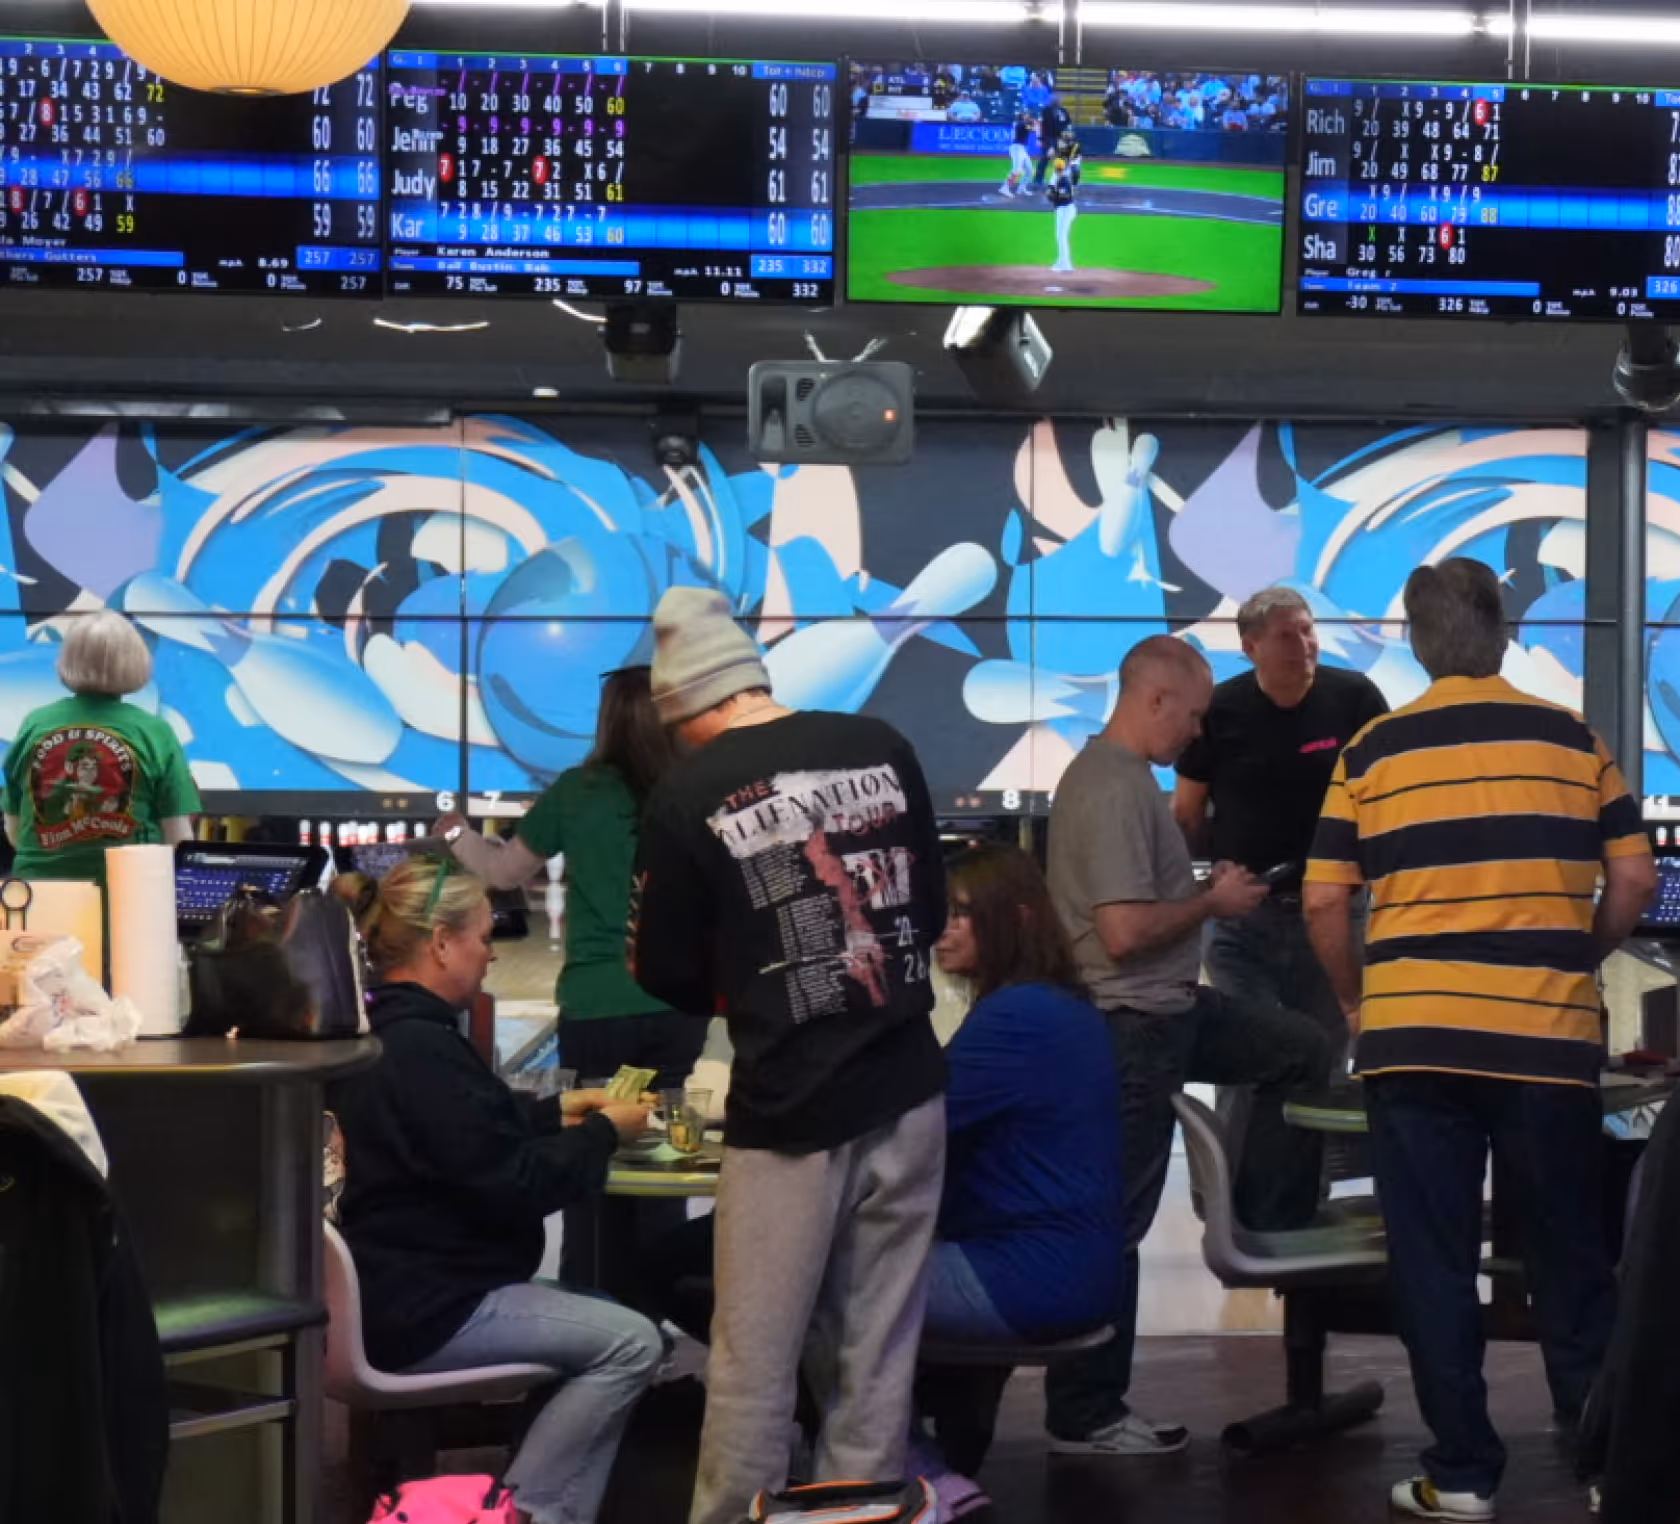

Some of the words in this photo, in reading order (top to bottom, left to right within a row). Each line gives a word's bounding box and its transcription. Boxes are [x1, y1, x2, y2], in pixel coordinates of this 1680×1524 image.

[19, 80, 35, 97] 17
[50, 81, 68, 98] 34
[82, 82, 100, 99] 43
[114, 83, 132, 101] 62
[147, 85, 163, 102] 72
[357, 74, 373, 107] 72
[770, 83, 787, 115] 60
[813, 85, 830, 117] 60
[450, 93, 466, 110] 10
[481, 94, 498, 111] 20
[512, 95, 530, 111] 30
[544, 96, 562, 112] 40
[575, 97, 593, 113] 50
[607, 97, 624, 114] 60
[1306, 108, 1344, 133] Rich
[1363, 120, 1379, 136] 20
[1392, 121, 1409, 137] 39
[1423, 122, 1440, 138] 48
[1454, 123, 1469, 139] 64
[1484, 123, 1499, 139] 71
[20, 124, 36, 141] 27
[51, 125, 68, 142] 36
[83, 126, 100, 143] 44
[116, 127, 132, 144] 51
[147, 128, 164, 146] 60
[313, 115, 330, 149] 60
[357, 117, 374, 151] 60
[769, 127, 786, 160] 54
[812, 128, 829, 160] 54
[458, 137, 466, 153] 9
[482, 138, 498, 154] 18
[512, 139, 529, 155] 27
[544, 139, 560, 156] 36
[575, 140, 592, 157] 45
[607, 140, 623, 158] 54
[1306, 152, 1336, 176] Jim
[1361, 163, 1377, 178] 20
[1392, 163, 1408, 179] 49
[1422, 164, 1438, 179] 68
[1452, 164, 1468, 180] 77
[1482, 165, 1498, 181] 87
[313, 160, 330, 192] 66
[357, 162, 374, 193] 66
[392, 169, 435, 201] Judy
[768, 170, 785, 202] 61
[811, 171, 828, 202] 61
[458, 182, 466, 197] 8
[481, 182, 498, 198] 15
[512, 183, 529, 198] 22
[544, 184, 560, 200] 31
[575, 184, 592, 200] 51
[607, 184, 623, 201] 61
[1305, 193, 1337, 216] Gre
[22, 213, 38, 229] 26
[53, 214, 69, 230] 42
[85, 214, 102, 231] 49
[116, 215, 134, 233] 59
[313, 204, 330, 237] 59
[357, 205, 374, 238] 59
[392, 214, 424, 238] Kar
[768, 213, 785, 245] 60
[811, 214, 828, 245] 60
[305, 251, 328, 264] 257
[437, 248, 476, 256] Karen
[485, 248, 549, 258] Anderson
[1304, 234, 1336, 260] Sha
[1358, 246, 1375, 261] 30
[1389, 247, 1404, 262] 56
[1419, 247, 1435, 262] 73
[1448, 248, 1465, 263] 80
[1664, 235, 1680, 267] 80
[759, 260, 782, 272] 235
[76, 268, 102, 282] 257
[341, 276, 366, 289] 257
[446, 277, 463, 289] 75
[534, 279, 560, 291] 235
[625, 281, 641, 294] 97
[793, 284, 818, 297] 332
[1655, 281, 1677, 293] 326
[1439, 298, 1463, 311] 326
[437, 791, 455, 811] 6
[484, 790, 500, 810] 7
[1001, 789, 1020, 810] 8
